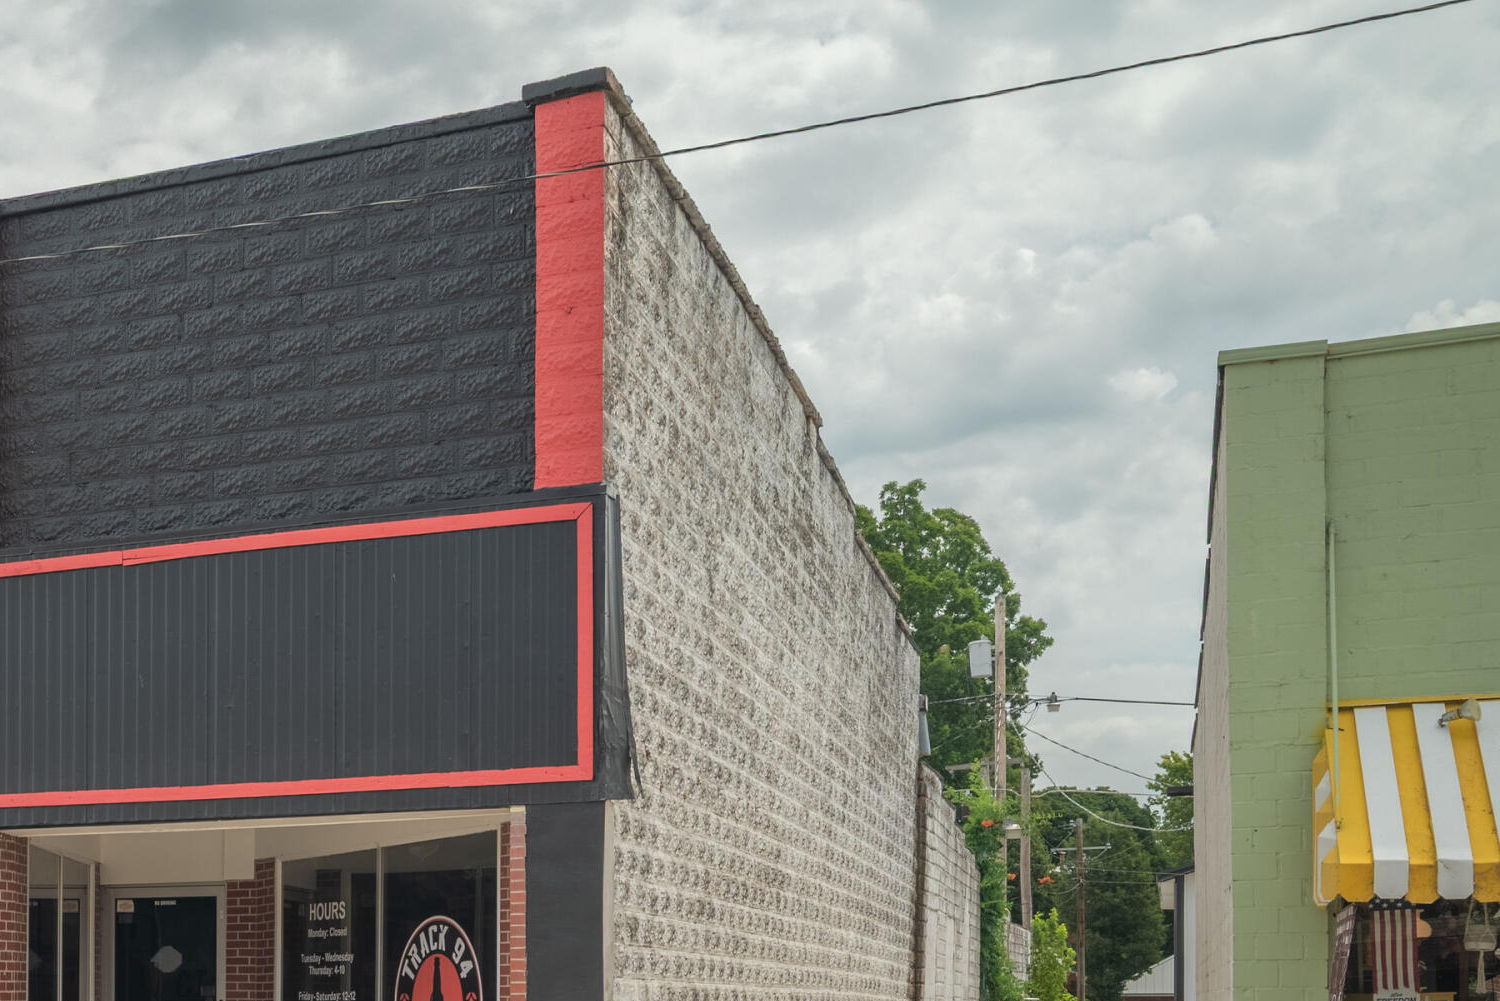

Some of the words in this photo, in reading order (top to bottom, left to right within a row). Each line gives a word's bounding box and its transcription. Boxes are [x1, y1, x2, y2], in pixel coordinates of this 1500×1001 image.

[309, 901, 346, 921] HOURS
[307, 928, 329, 939] Monday:
[329, 927, 348, 937] Closed
[301, 953, 322, 964] Tuesday
[325, 951, 355, 964] Wednesday
[401, 924, 450, 981] TRACK
[452, 937, 474, 980] 94
[309, 965, 333, 977] Thursday:
